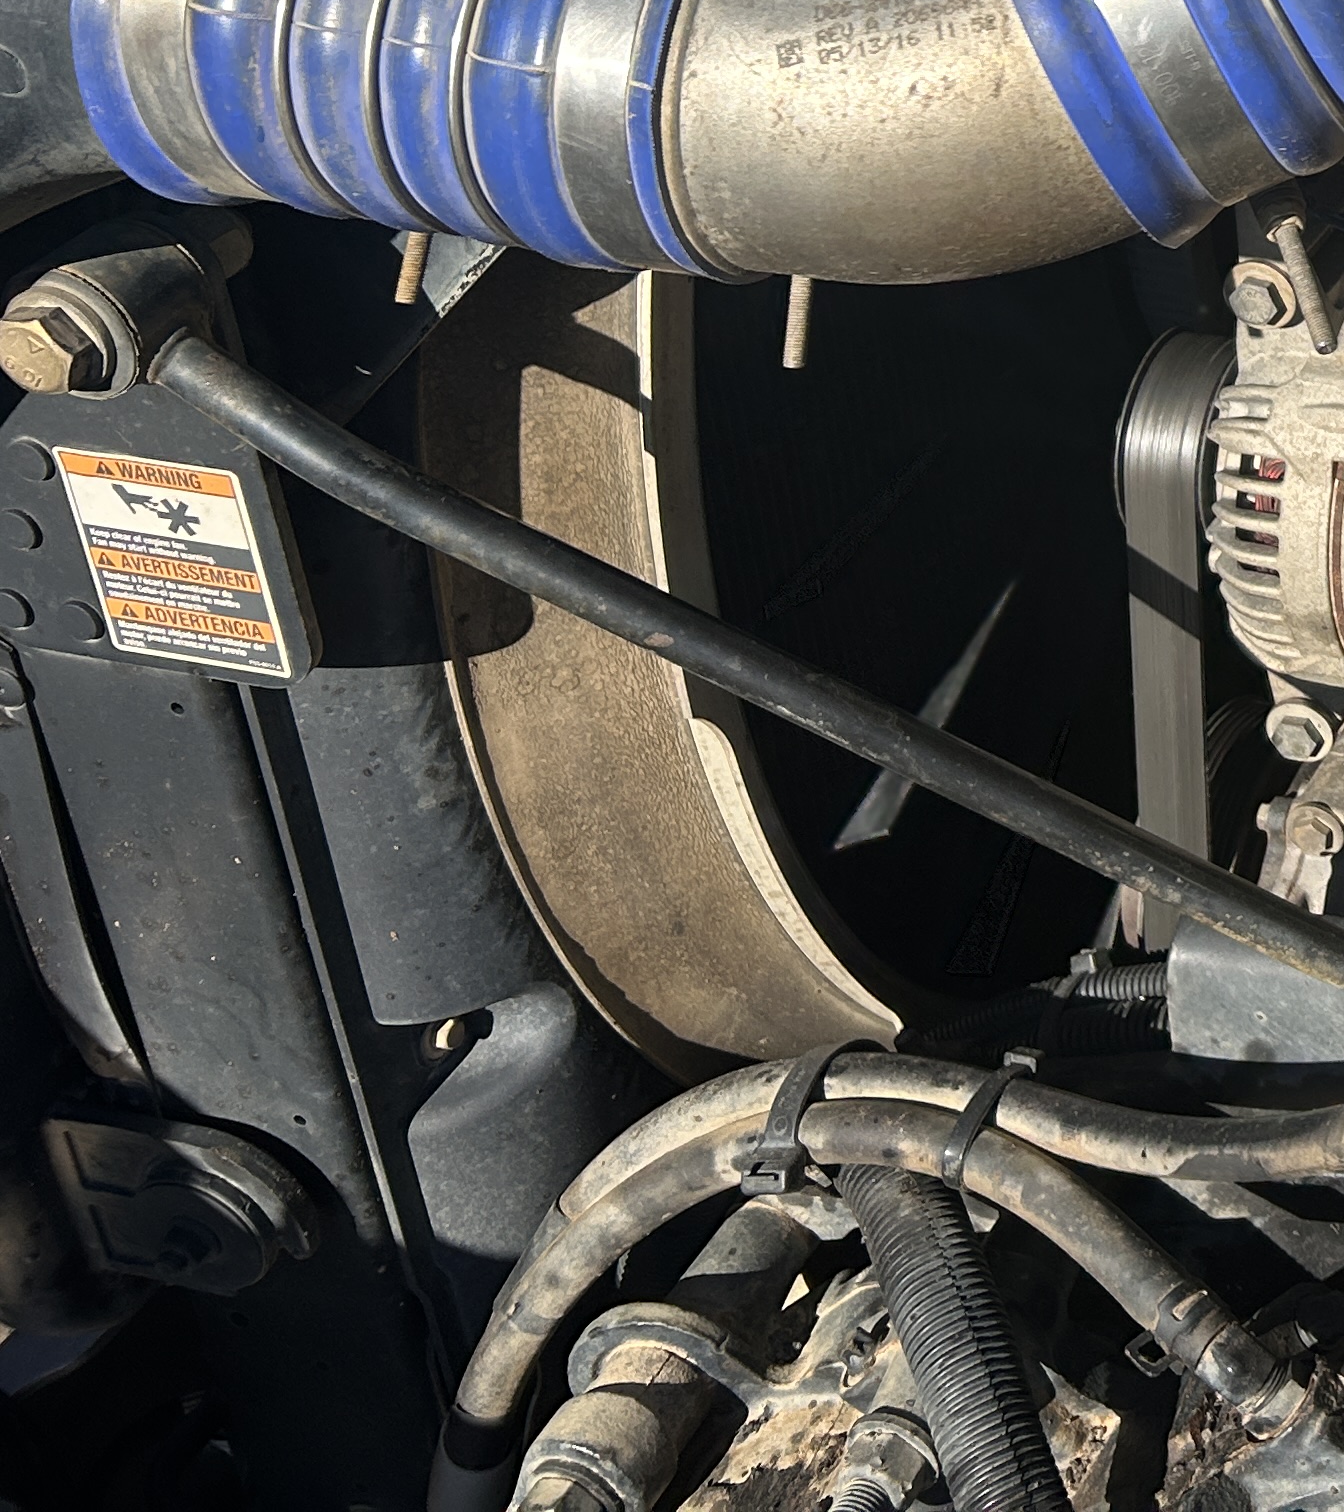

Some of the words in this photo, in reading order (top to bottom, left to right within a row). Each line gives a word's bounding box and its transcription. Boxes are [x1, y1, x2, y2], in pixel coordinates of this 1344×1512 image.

[115, 462, 202, 490] WARNING
[121, 554, 256, 591] AVERTISSEMENT
[144, 606, 264, 639] ADVERTENCIA
